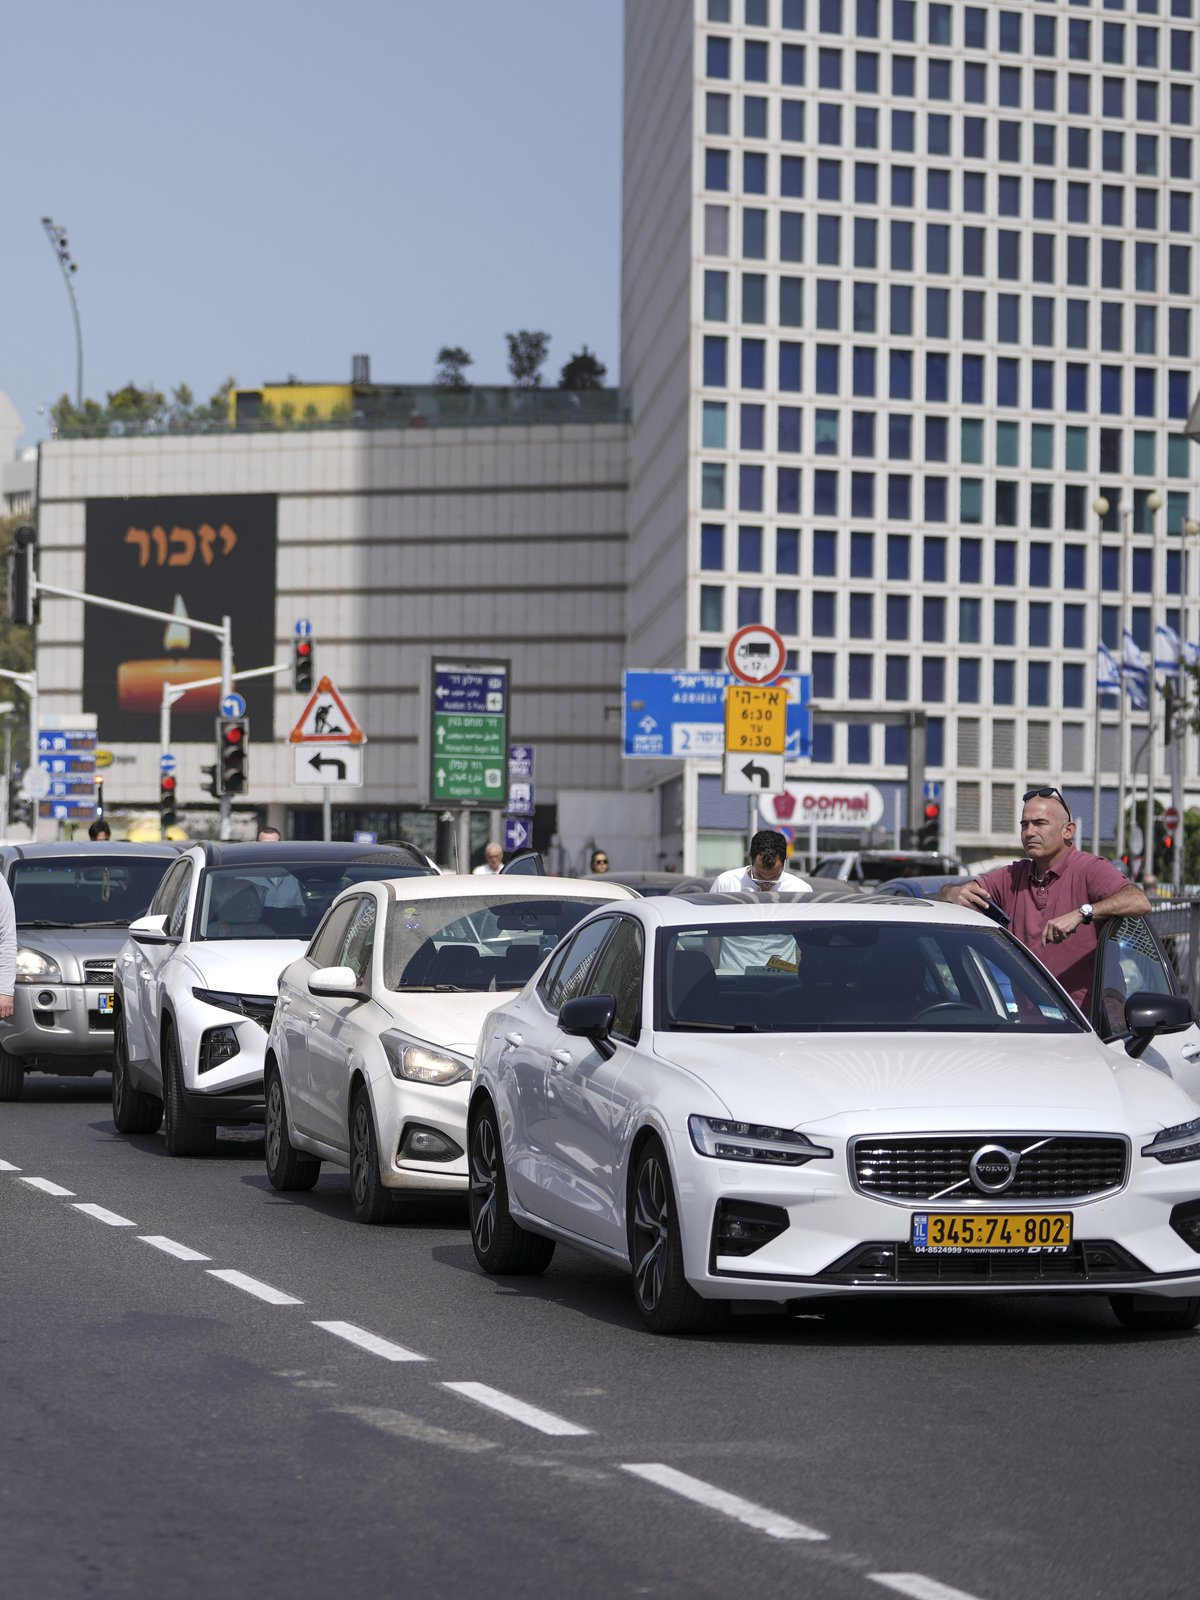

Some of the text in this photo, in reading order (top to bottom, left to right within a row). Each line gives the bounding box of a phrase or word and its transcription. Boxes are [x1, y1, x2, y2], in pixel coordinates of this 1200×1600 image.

[124, 523, 238, 567] יזכור
[672, 692, 717, 704] AZRIELI
[741, 709, 773, 721] 6:30
[680, 729, 691, 750] 2
[740, 735, 772, 747] 9:30
